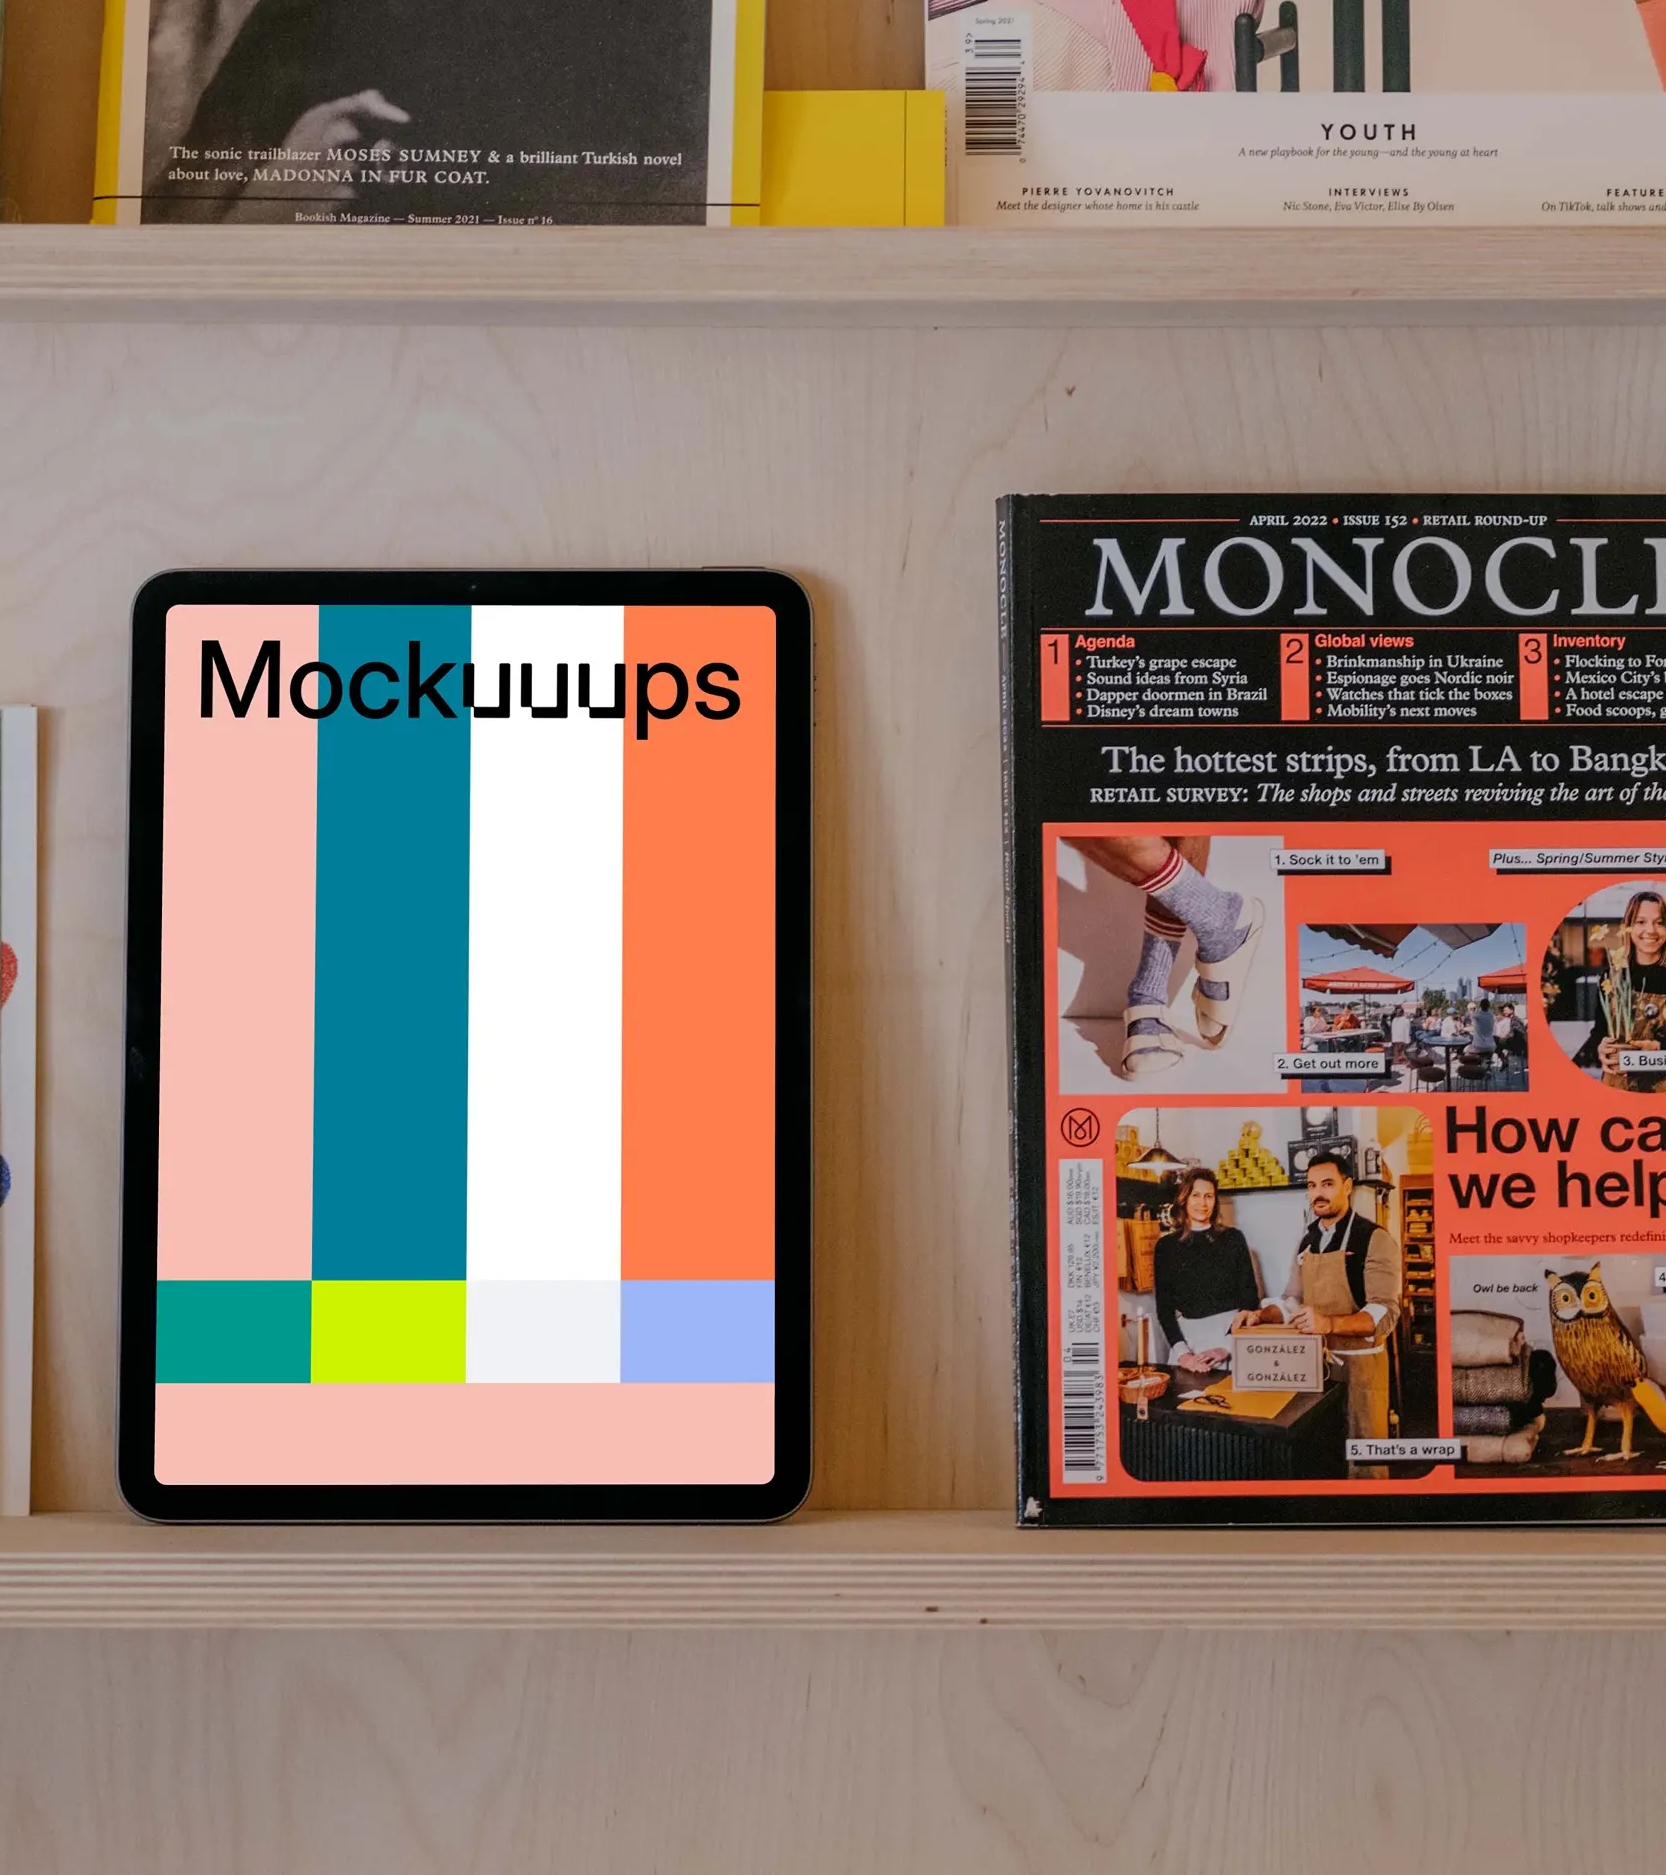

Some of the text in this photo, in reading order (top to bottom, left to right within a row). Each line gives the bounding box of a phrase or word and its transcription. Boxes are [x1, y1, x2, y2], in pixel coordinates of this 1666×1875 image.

[1321, 123, 1415, 140] YOUTH
[168, 145, 681, 165] The sonic trailblazer MOSES SUMNEY & a brilliant Turkish novel
[168, 167, 489, 184] about love, MADONNA IN FUR COAT.
[1022, 187, 1173, 196] PIERRE YOVANOVITCH
[1329, 188, 1408, 196] INTERVIEWS
[1283, 200, 1454, 213] Nic Stone, Eva Victor, Elise By Olsen
[295, 212, 336, 222] Bookish
[339, 212, 390, 224] Magazine
[407, 213, 452, 223] Summer
[455, 214, 479, 224] 2021
[498, 215, 525, 224] Issue
[541, 216, 553, 225] 16
[1249, 515, 1547, 528] APRIL 2022 ISSUE 152 RETAIL ROUND-UP
[1074, 634, 1135, 651] Agenda
[1314, 633, 1414, 647] Global views
[1553, 633, 1626, 650] Inventory
[1047, 639, 1059, 665] 1
[1285, 638, 1305, 664] 2
[1522, 637, 1541, 663] 3
[1085, 655, 1237, 671] Turkey's grape escape
[1086, 671, 1248, 687] Sound ideas from Syria
[199, 639, 741, 741] Mockuuups
[1086, 687, 1267, 704] Dapper doormen in Brazil
[1087, 704, 1239, 720] Disney's dream towns
[1101, 745, 1165, 773] The
[1173, 745, 1277, 773] hottest
[1285, 745, 1376, 779] strips,
[1385, 745, 1460, 772] from
[1468, 745, 1522, 771] LA
[1529, 750, 1559, 772] to
[1275, 854, 1285, 865] 1.
[1289, 854, 1321, 865] Sock
[1326, 855, 1334, 865] it
[1338, 855, 1351, 865] to
[1492, 853, 1531, 863] Plus...
[1536, 852, 1640, 865] Spring/Summer
[1623, 1055, 1634, 1066] 3.
[1445, 1105, 1580, 1153] How
[1447, 1172, 1536, 1209] we
